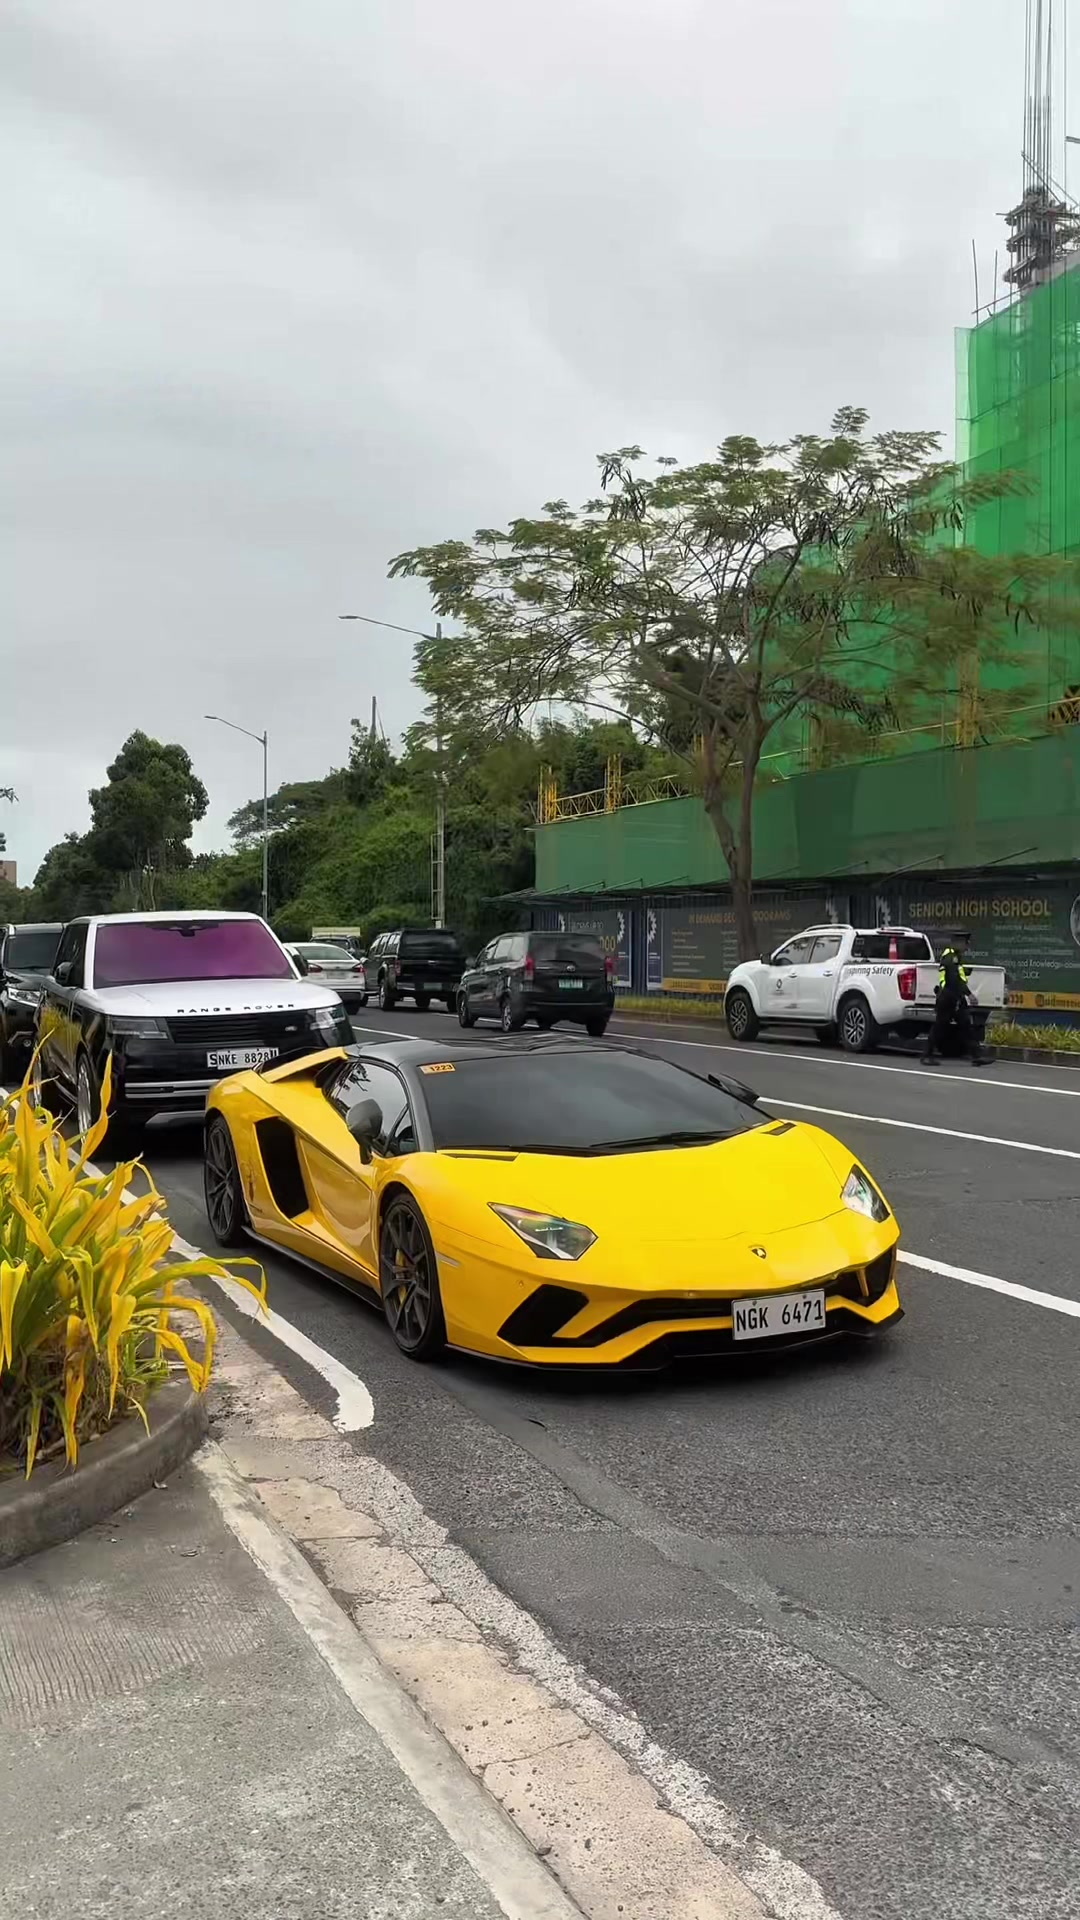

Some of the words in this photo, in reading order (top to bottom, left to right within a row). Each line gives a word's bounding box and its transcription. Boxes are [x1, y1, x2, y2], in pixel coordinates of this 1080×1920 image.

[909, 901, 951, 918] SENIOR
[955, 900, 987, 918] HIGH
[991, 898, 1051, 917] SCHOOL
[871, 965, 895, 977] Safety
[736, 1307, 769, 1332] NGK
[781, 1299, 823, 1326] 6471
